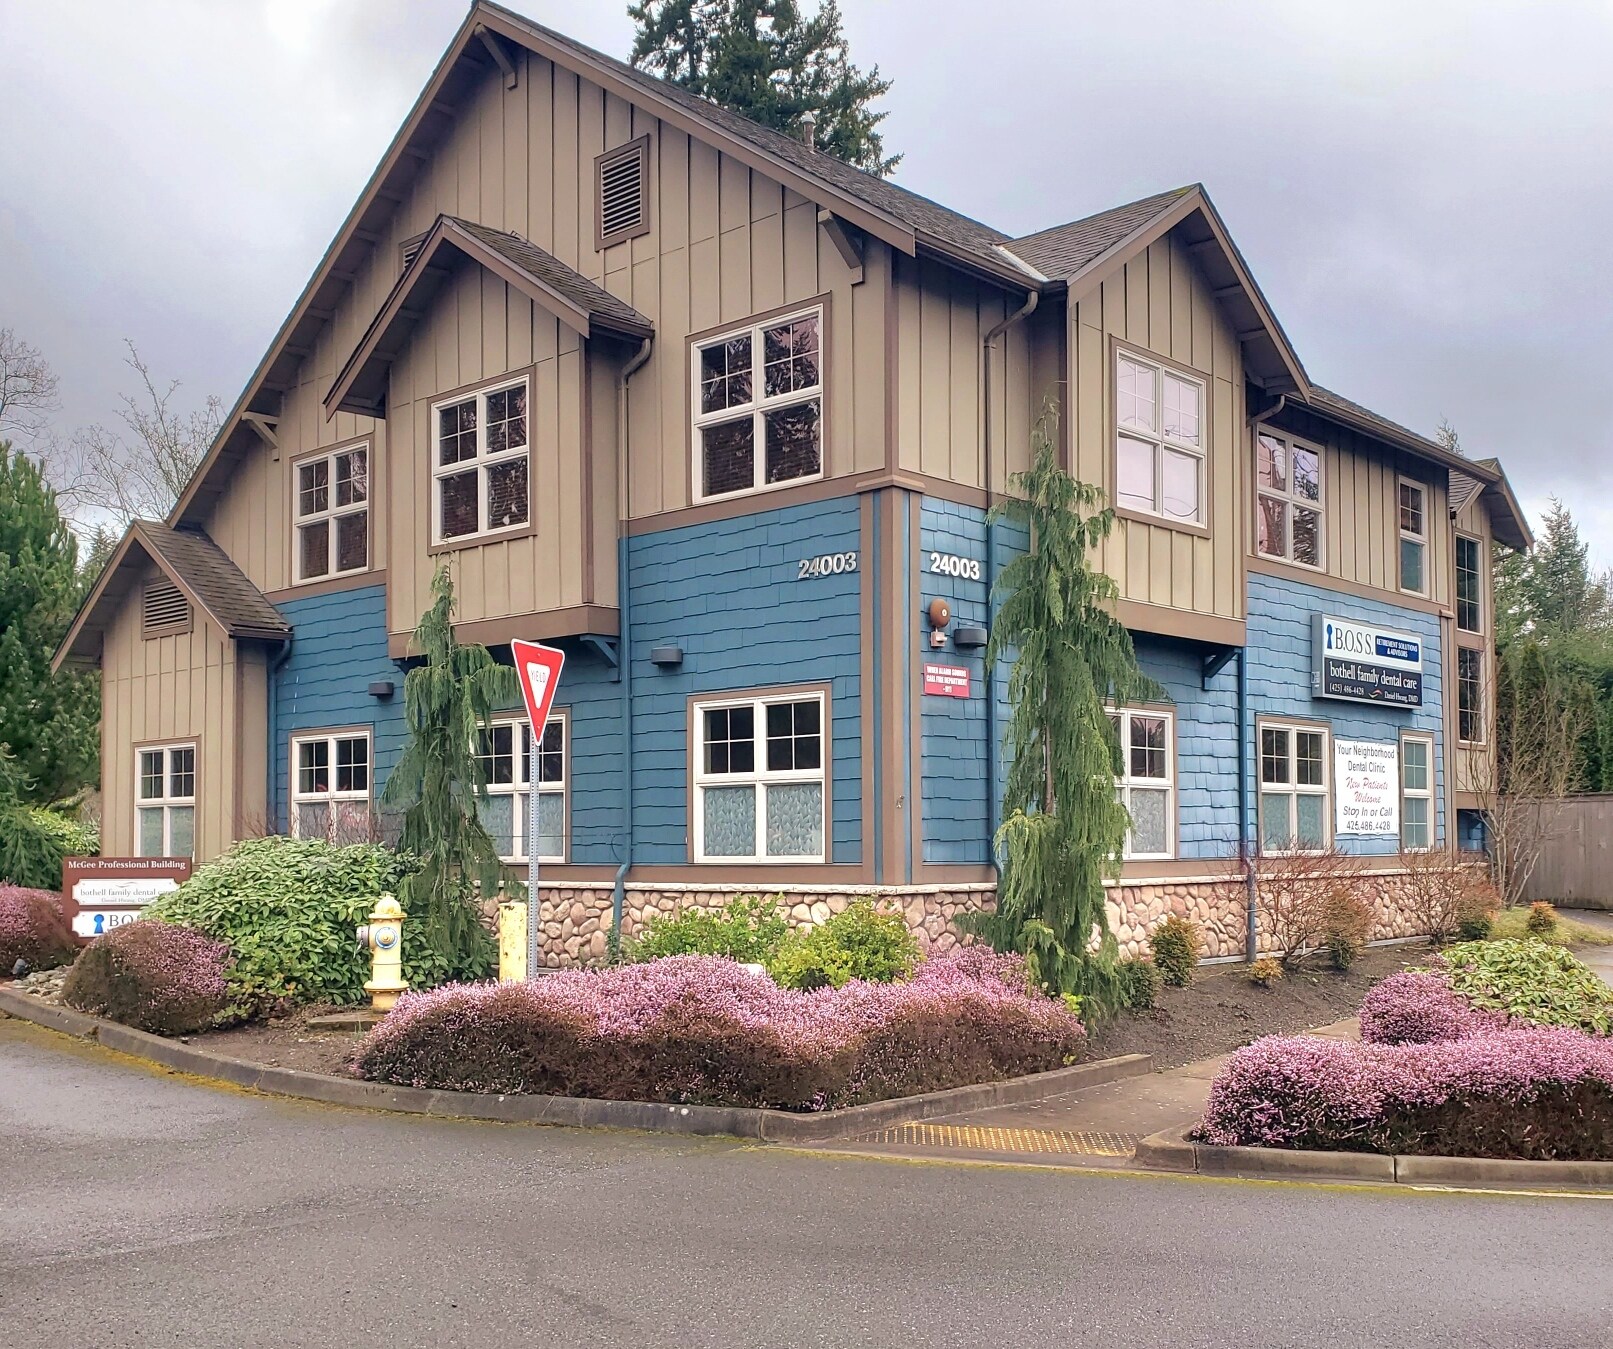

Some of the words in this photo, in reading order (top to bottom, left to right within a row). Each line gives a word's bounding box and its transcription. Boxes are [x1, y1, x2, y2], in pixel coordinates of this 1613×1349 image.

[797, 551, 857, 579] 24003
[930, 552, 980, 580] 24003
[530, 669, 547, 683] YIELD
[1329, 661, 1355, 680] bothell
[1357, 666, 1379, 687] family
[1381, 670, 1402, 687] dental
[1403, 677, 1417, 690] care
[1329, 682, 1342, 693] (425)
[1337, 743, 1352, 755] Your
[1353, 744, 1395, 759] Neighborhood
[1347, 760, 1367, 772] Dental
[1368, 761, 1385, 773] Clinic
[1362, 777, 1388, 790] Patients
[1354, 791, 1381, 804] Welcome
[1342, 805, 1360, 818] Stop
[1361, 807, 1368, 817] In
[1369, 809, 1378, 817] or
[1379, 806, 1393, 817] Call
[68, 861, 96, 869] McGee
[98, 860, 149, 869] Professional
[151, 860, 186, 870] Building
[80, 888, 106, 896] bothell
[108, 888, 132, 898] family
[133, 888, 156, 896] dental
